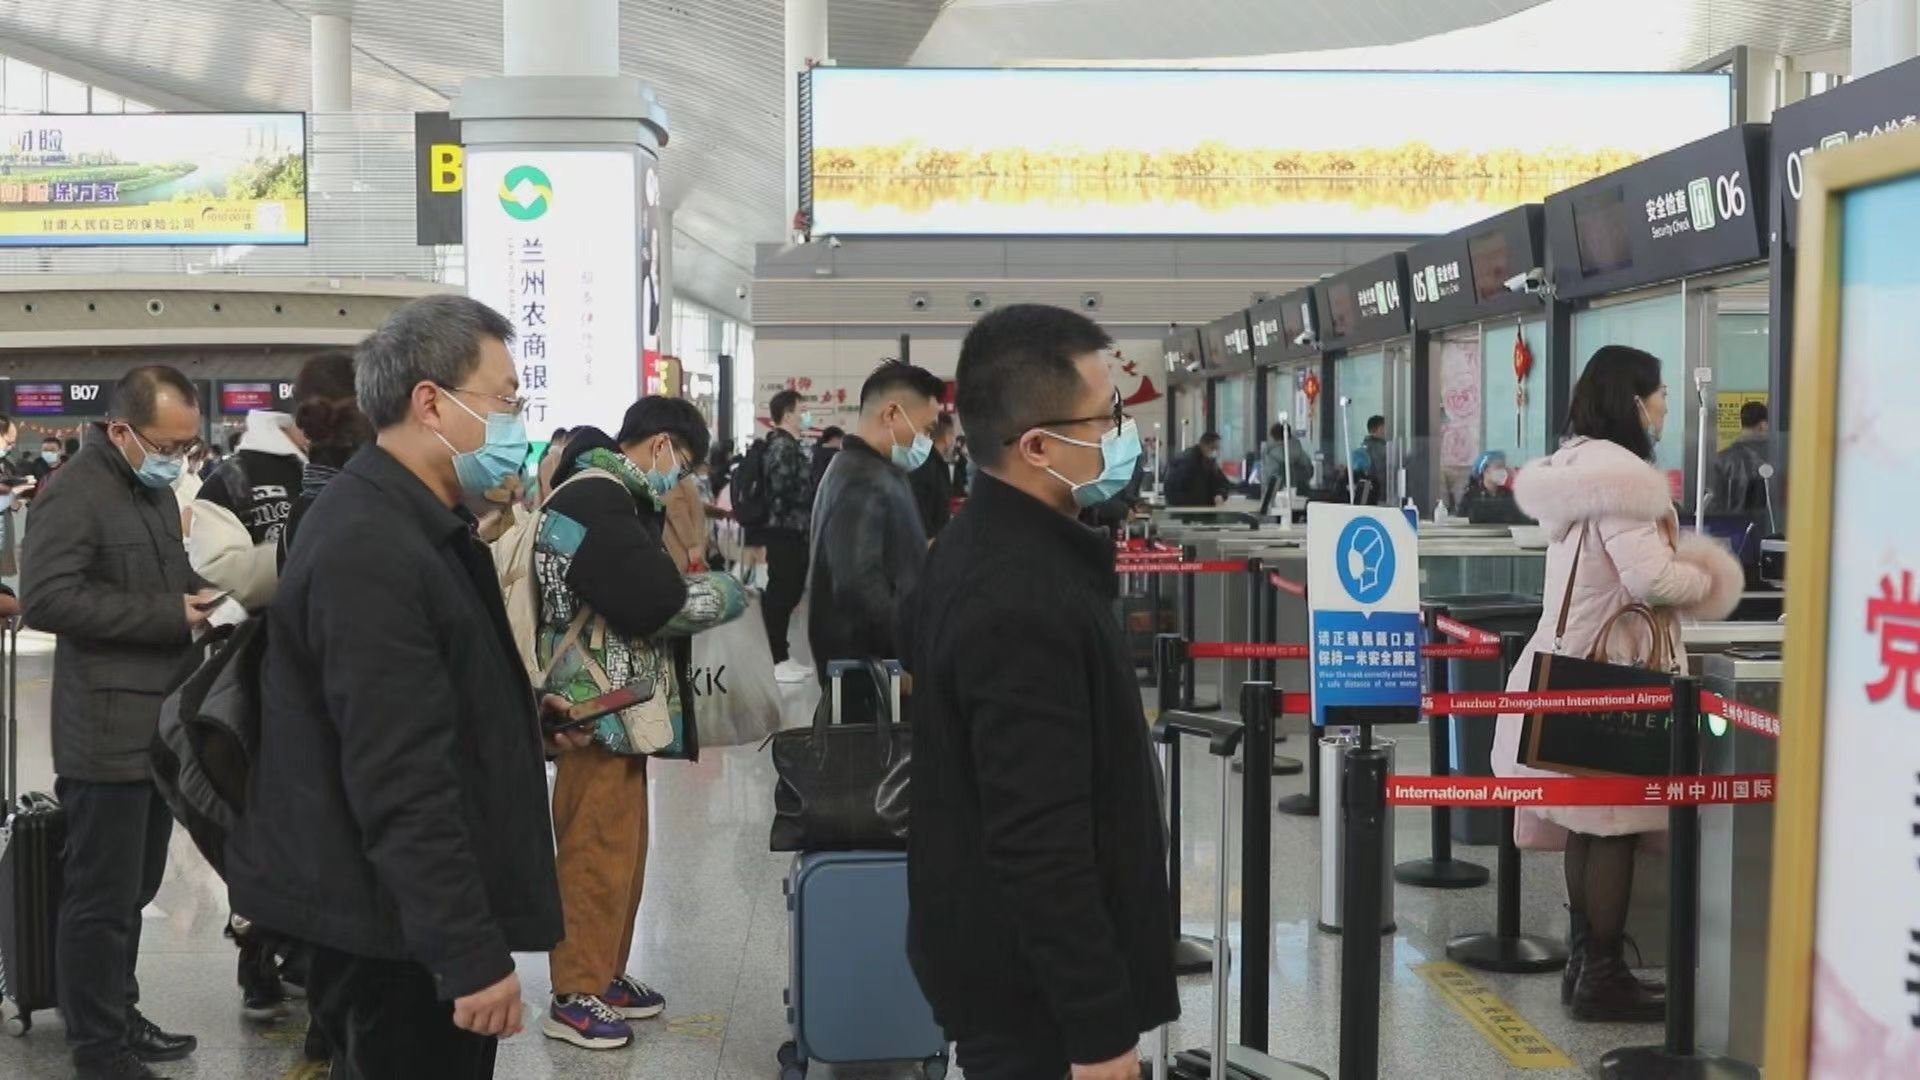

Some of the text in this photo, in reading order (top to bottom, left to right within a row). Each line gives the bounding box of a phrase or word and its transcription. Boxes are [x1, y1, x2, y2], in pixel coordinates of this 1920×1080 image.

[431, 145, 462, 192] B
[1645, 189, 1688, 222] 安全检查
[1716, 171, 1746, 220] 06
[43, 216, 195, 231] 甘肃人民自己的保险公司
[1651, 216, 1690, 239] Security Check
[1386, 280, 1400, 310] 04
[1412, 270, 1427, 303] 05
[521, 237, 549, 424] 兰州农商银行
[70, 384, 99, 400] B07
[1318, 631, 1415, 646] 请正确佩戴口罩
[1318, 650, 1416, 666] 保持一米安全距离
[1327, 680, 1340, 688] safe
[1344, 680, 1371, 688] distance
[1364, 671, 1390, 680] correctly
[1450, 697, 1496, 709] Lanzhou
[1498, 695, 1565, 710] Zhongchuan
[1566, 693, 1635, 707] International
[1395, 785, 1488, 801] International
[1492, 785, 1544, 803] Airport
[1644, 779, 1773, 801] 兰州中川国际
